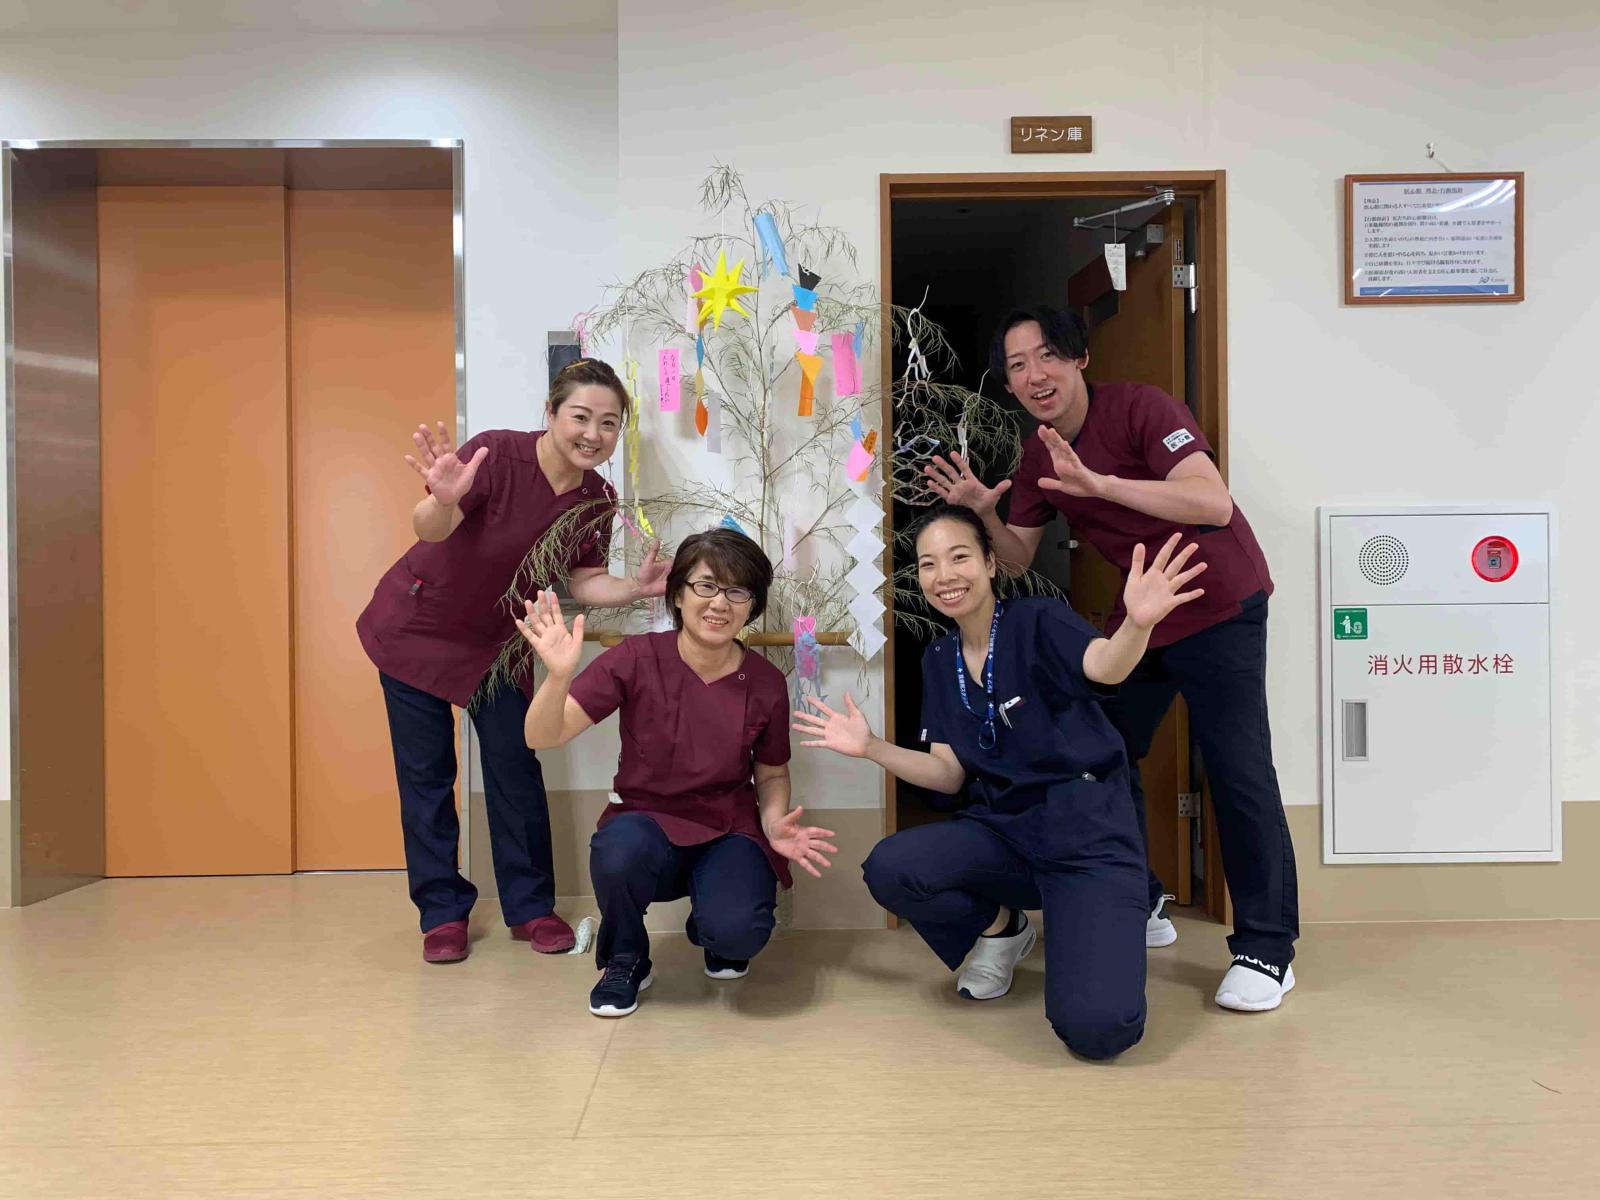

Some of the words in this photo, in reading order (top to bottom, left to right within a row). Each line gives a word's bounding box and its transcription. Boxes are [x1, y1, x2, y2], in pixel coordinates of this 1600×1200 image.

[1021, 126, 1083, 142] リネン庫
[1367, 653, 1515, 676] 消火用散水栓
